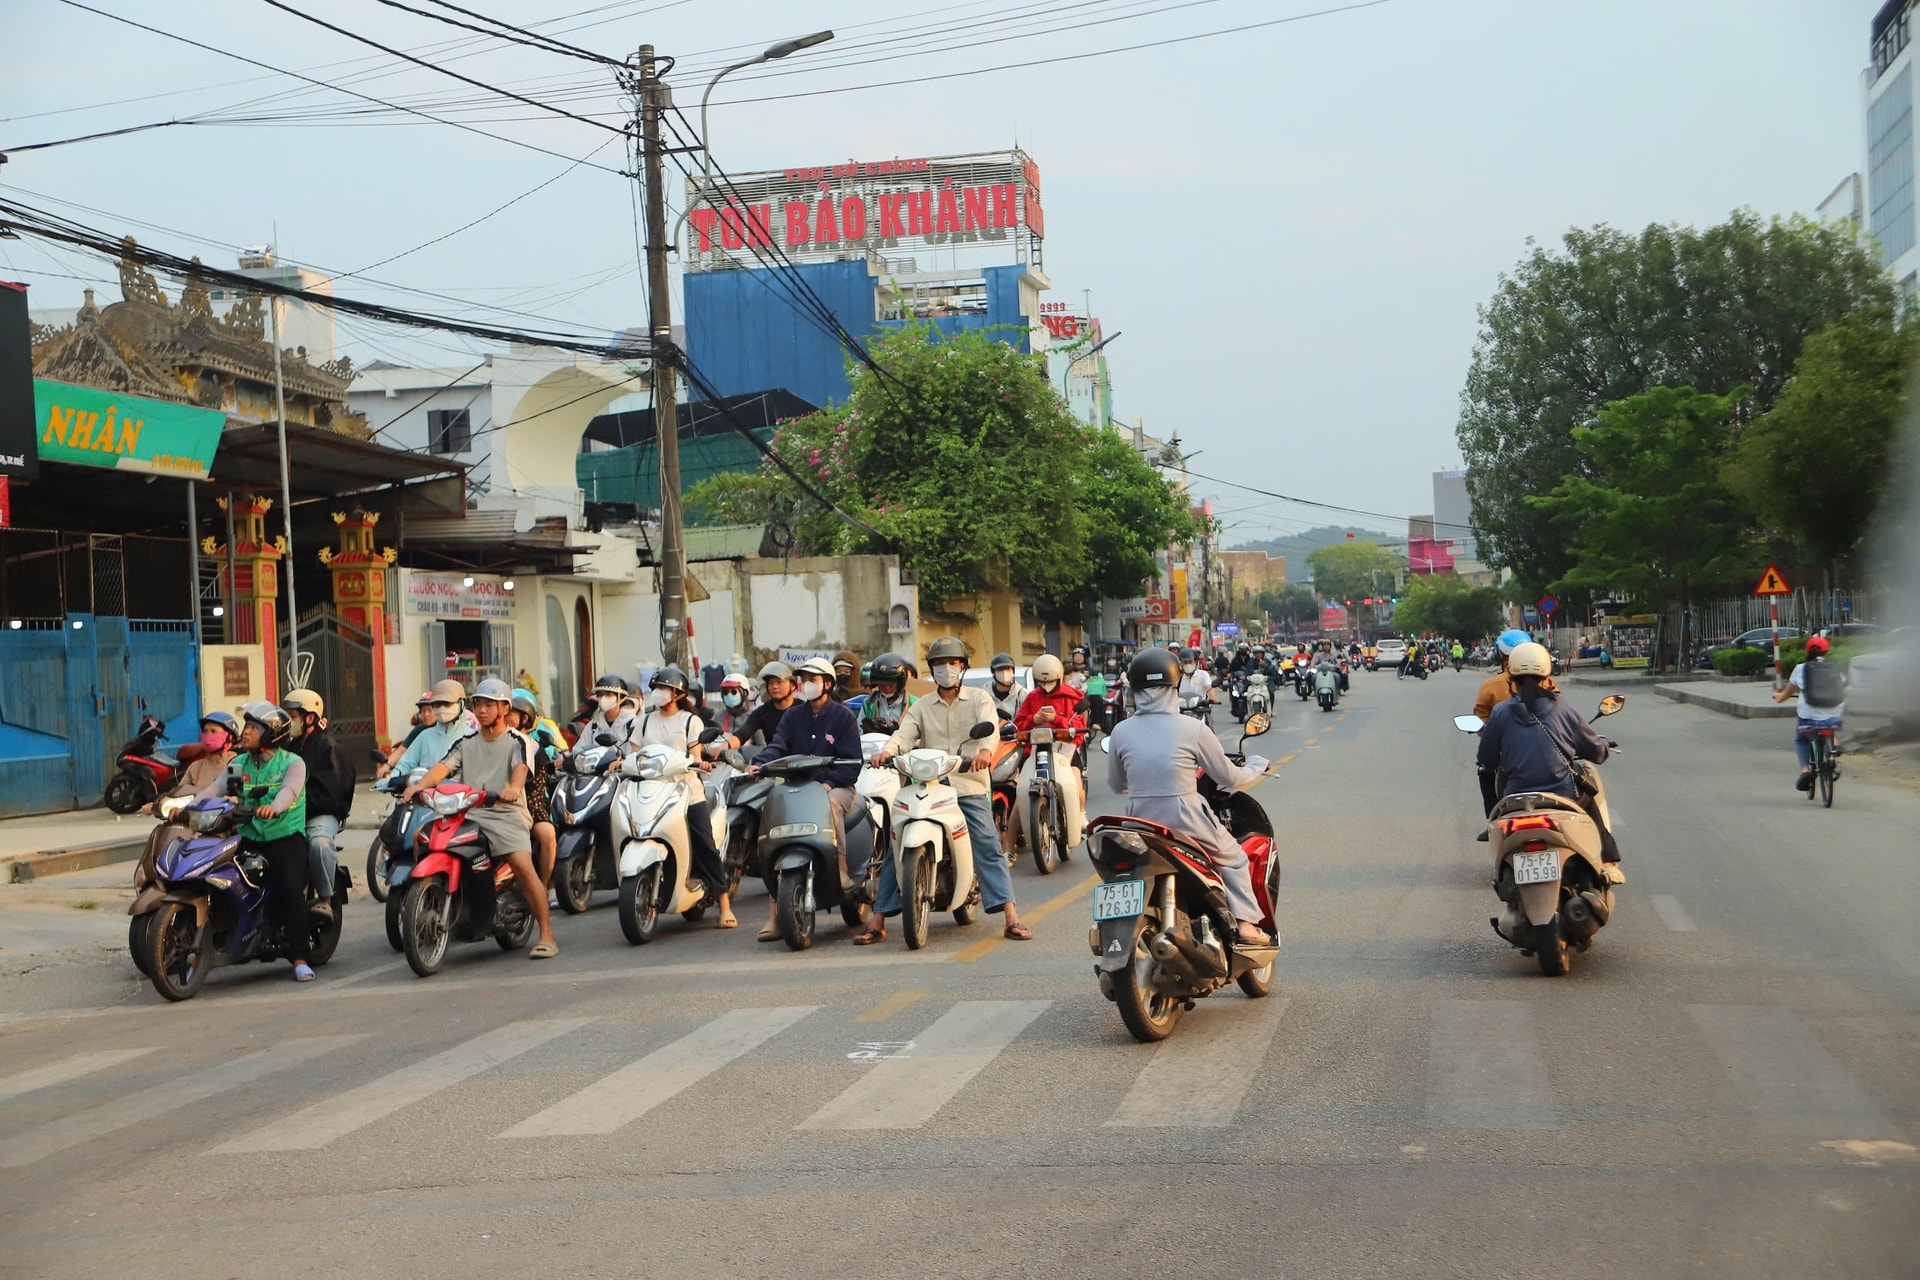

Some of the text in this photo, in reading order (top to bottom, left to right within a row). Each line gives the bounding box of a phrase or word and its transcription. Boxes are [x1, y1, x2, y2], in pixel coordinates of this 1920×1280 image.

[864, 155, 929, 176] CHÍNH
[783, 181, 866, 246] BẢO
[877, 176, 1018, 237] KHÁNH
[1040, 315, 1078, 337] NG
[42, 404, 145, 455] NHÂN
[1520, 853, 1552, 868] 75-F2
[1517, 866, 1557, 882] 015.98
[1103, 884, 1135, 900] 75-G1
[1099, 899, 1139, 917] 126.37
